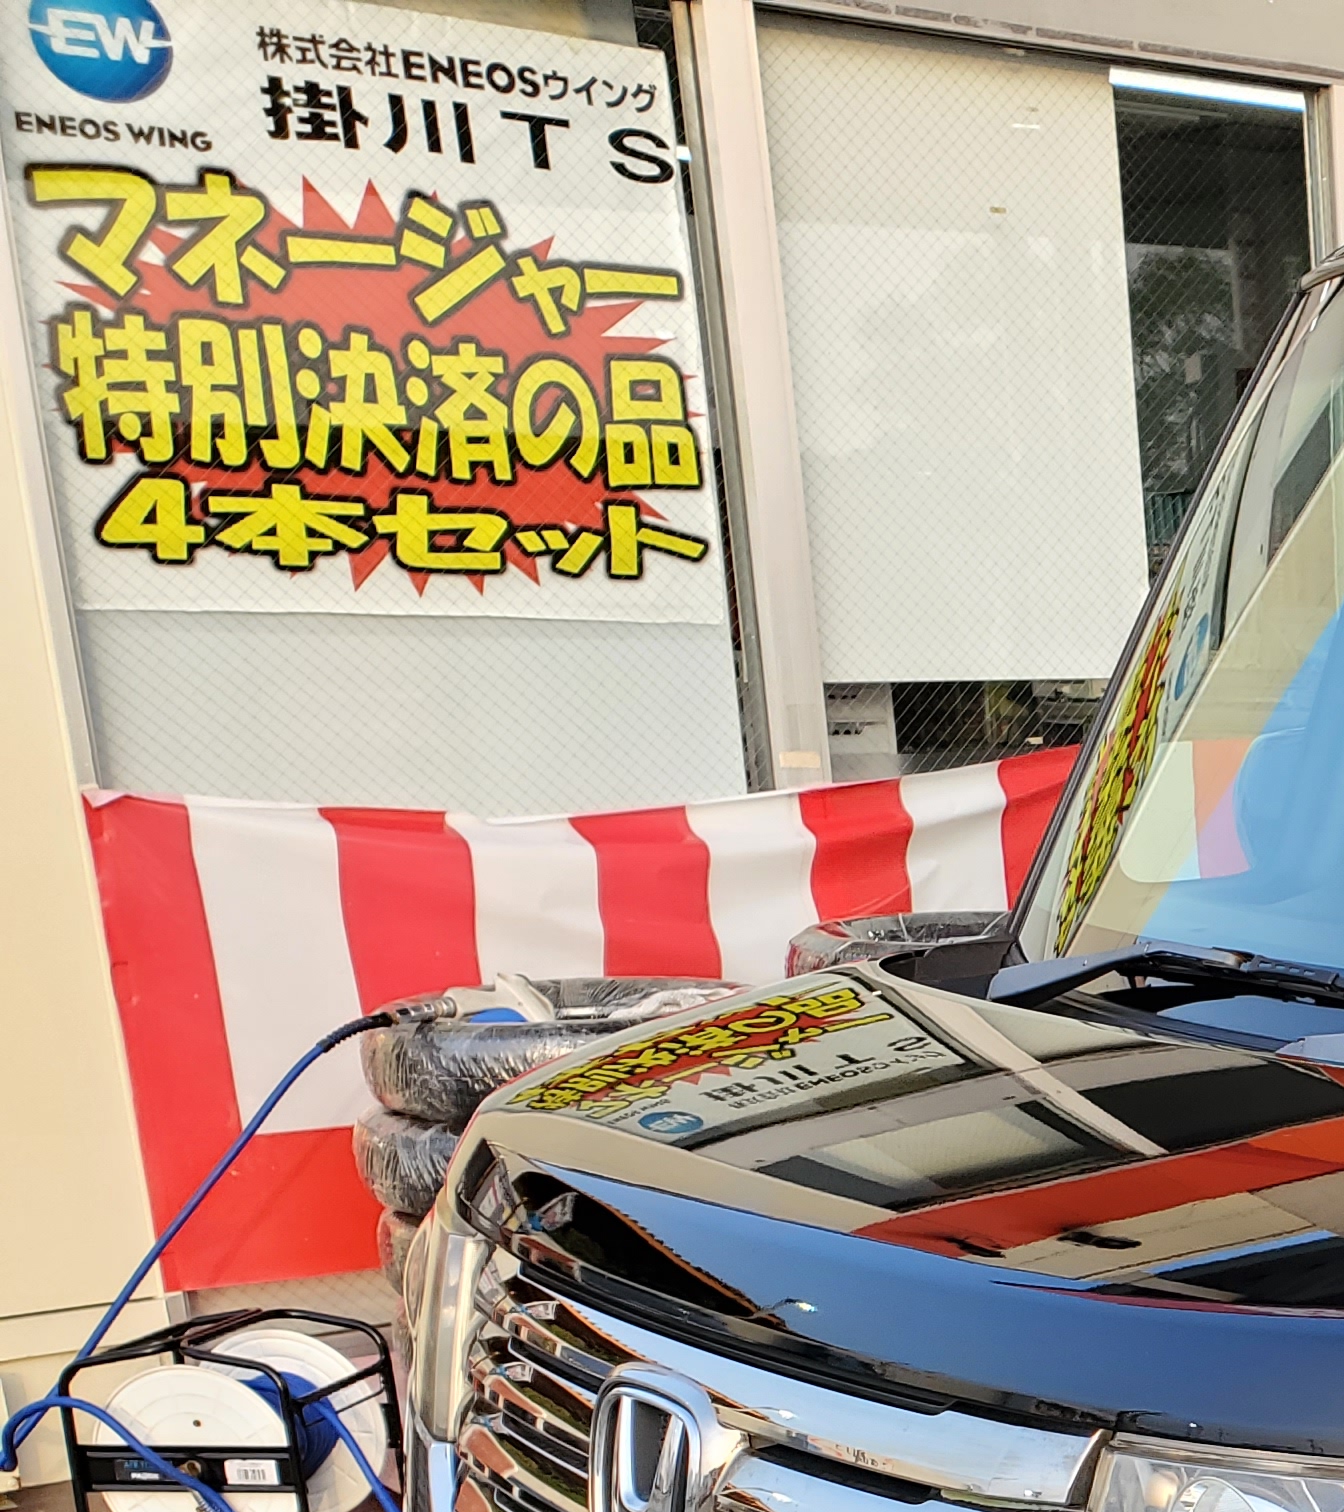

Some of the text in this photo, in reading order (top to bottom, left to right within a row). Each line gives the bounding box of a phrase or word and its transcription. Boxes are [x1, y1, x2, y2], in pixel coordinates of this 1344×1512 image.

[256, 25, 658, 114] 株式会社ENEOSウイング
[14, 110, 213, 152] ENEOS WING
[24, 162, 683, 338] マネージャー
[51, 303, 701, 489] 特別決済の品
[94, 476, 707, 578] 4本セット
